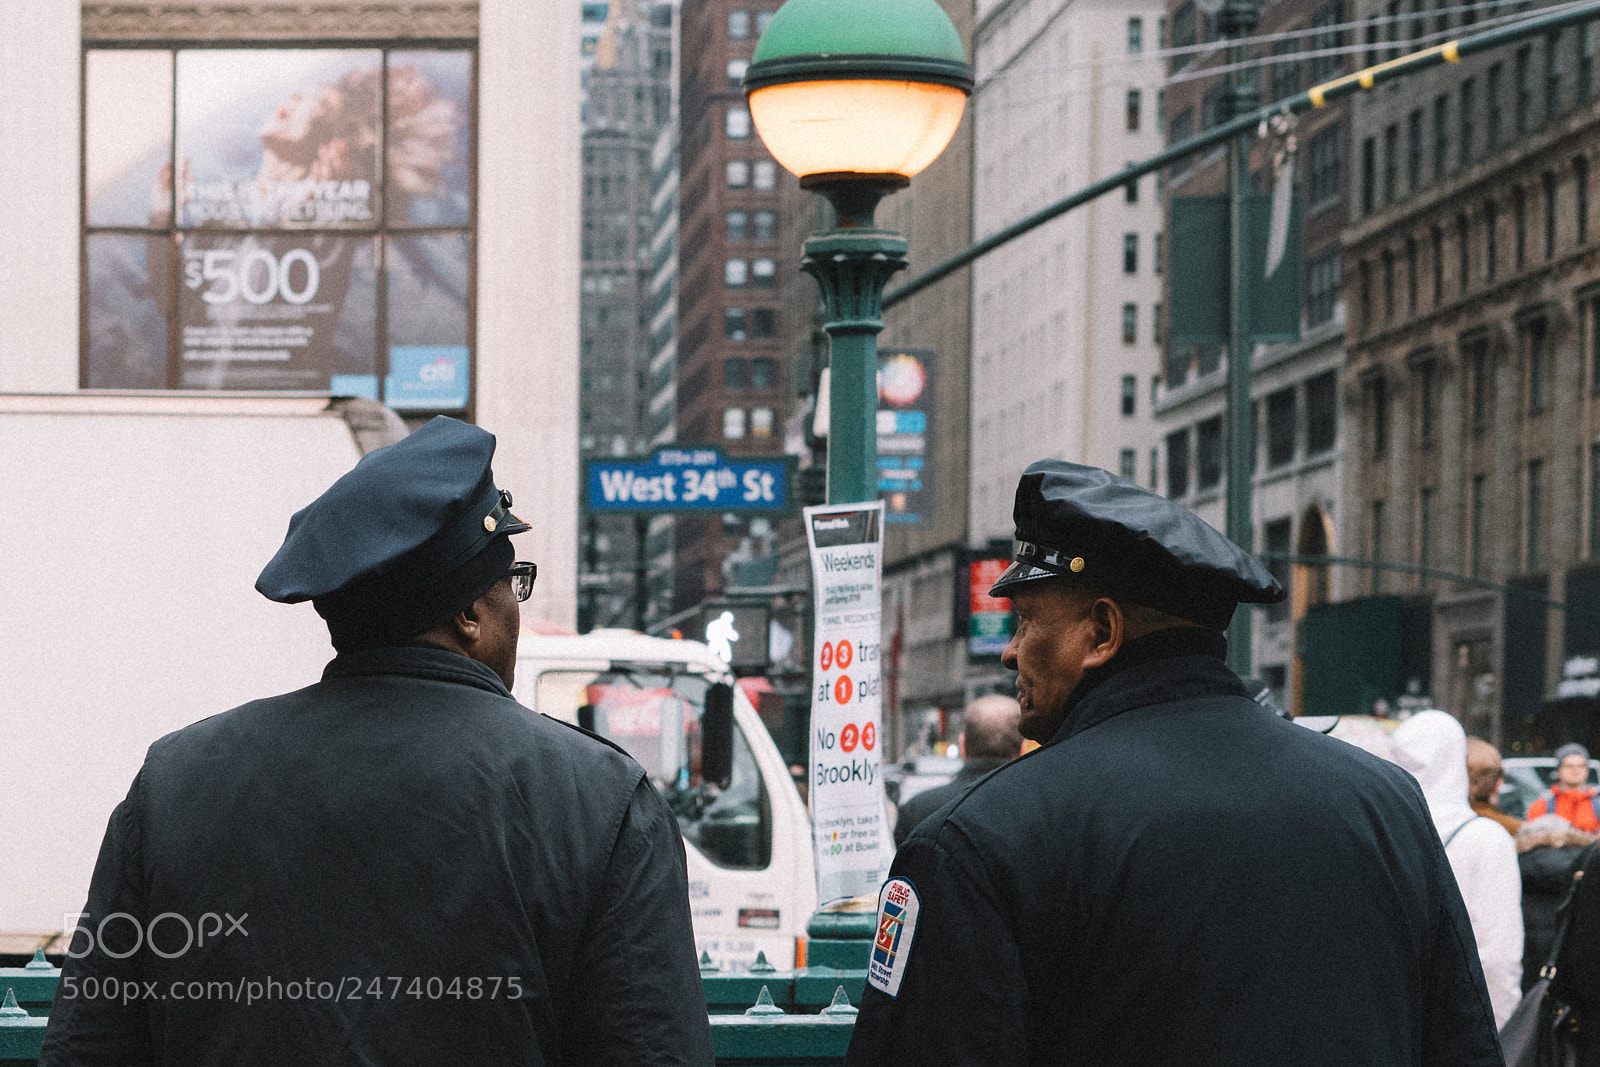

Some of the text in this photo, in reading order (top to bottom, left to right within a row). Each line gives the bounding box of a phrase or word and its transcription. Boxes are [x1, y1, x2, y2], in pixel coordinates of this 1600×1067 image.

[184, 248, 321, 304] $500
[600, 468, 775, 502] West 34th St
[820, 551, 875, 572] Weekends
[818, 679, 830, 702] at
[817, 728, 836, 751] No
[887, 891, 909, 907] SAFETY
[890, 882, 911, 898] PUBLIC
